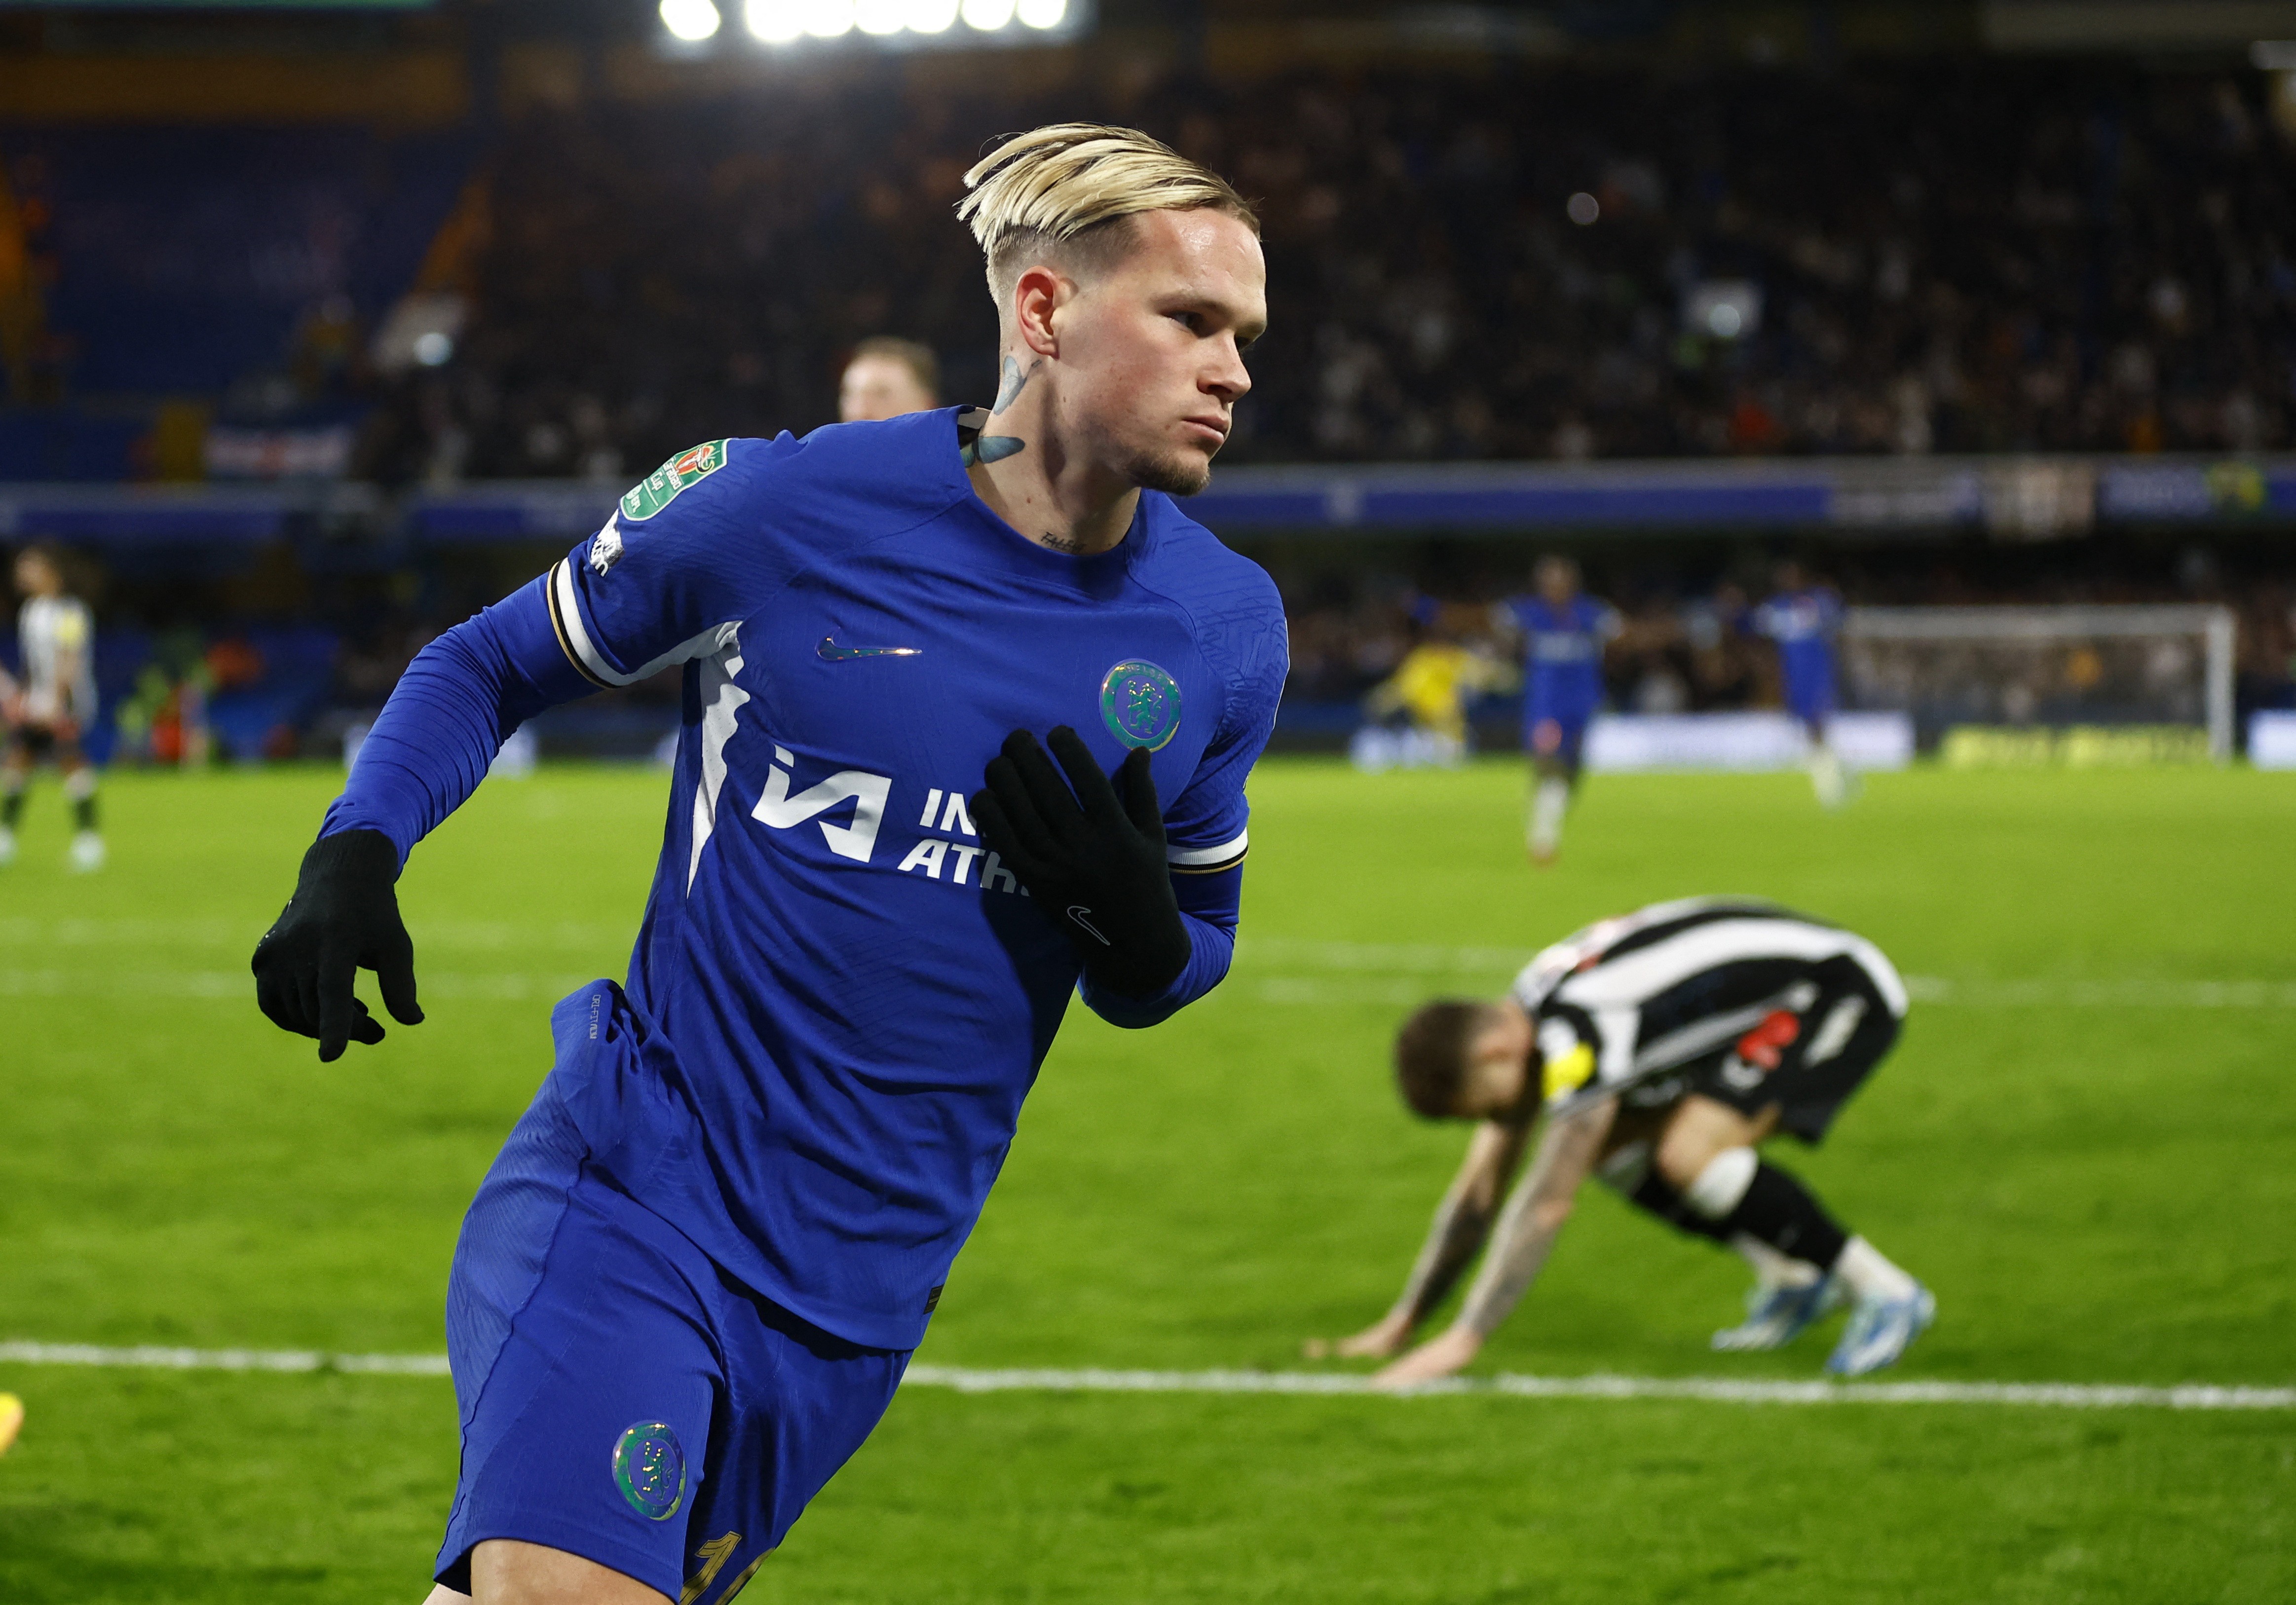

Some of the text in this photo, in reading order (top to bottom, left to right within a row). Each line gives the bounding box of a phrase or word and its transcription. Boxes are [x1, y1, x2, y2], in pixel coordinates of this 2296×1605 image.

[650, 471, 665, 491] Cup
[663, 457, 683, 490] Carabao
[630, 494, 641, 514] EFL
[919, 788, 986, 838] IN
[897, 838, 1031, 897] ATH
[590, 994, 601, 1023] DRI-FIT
